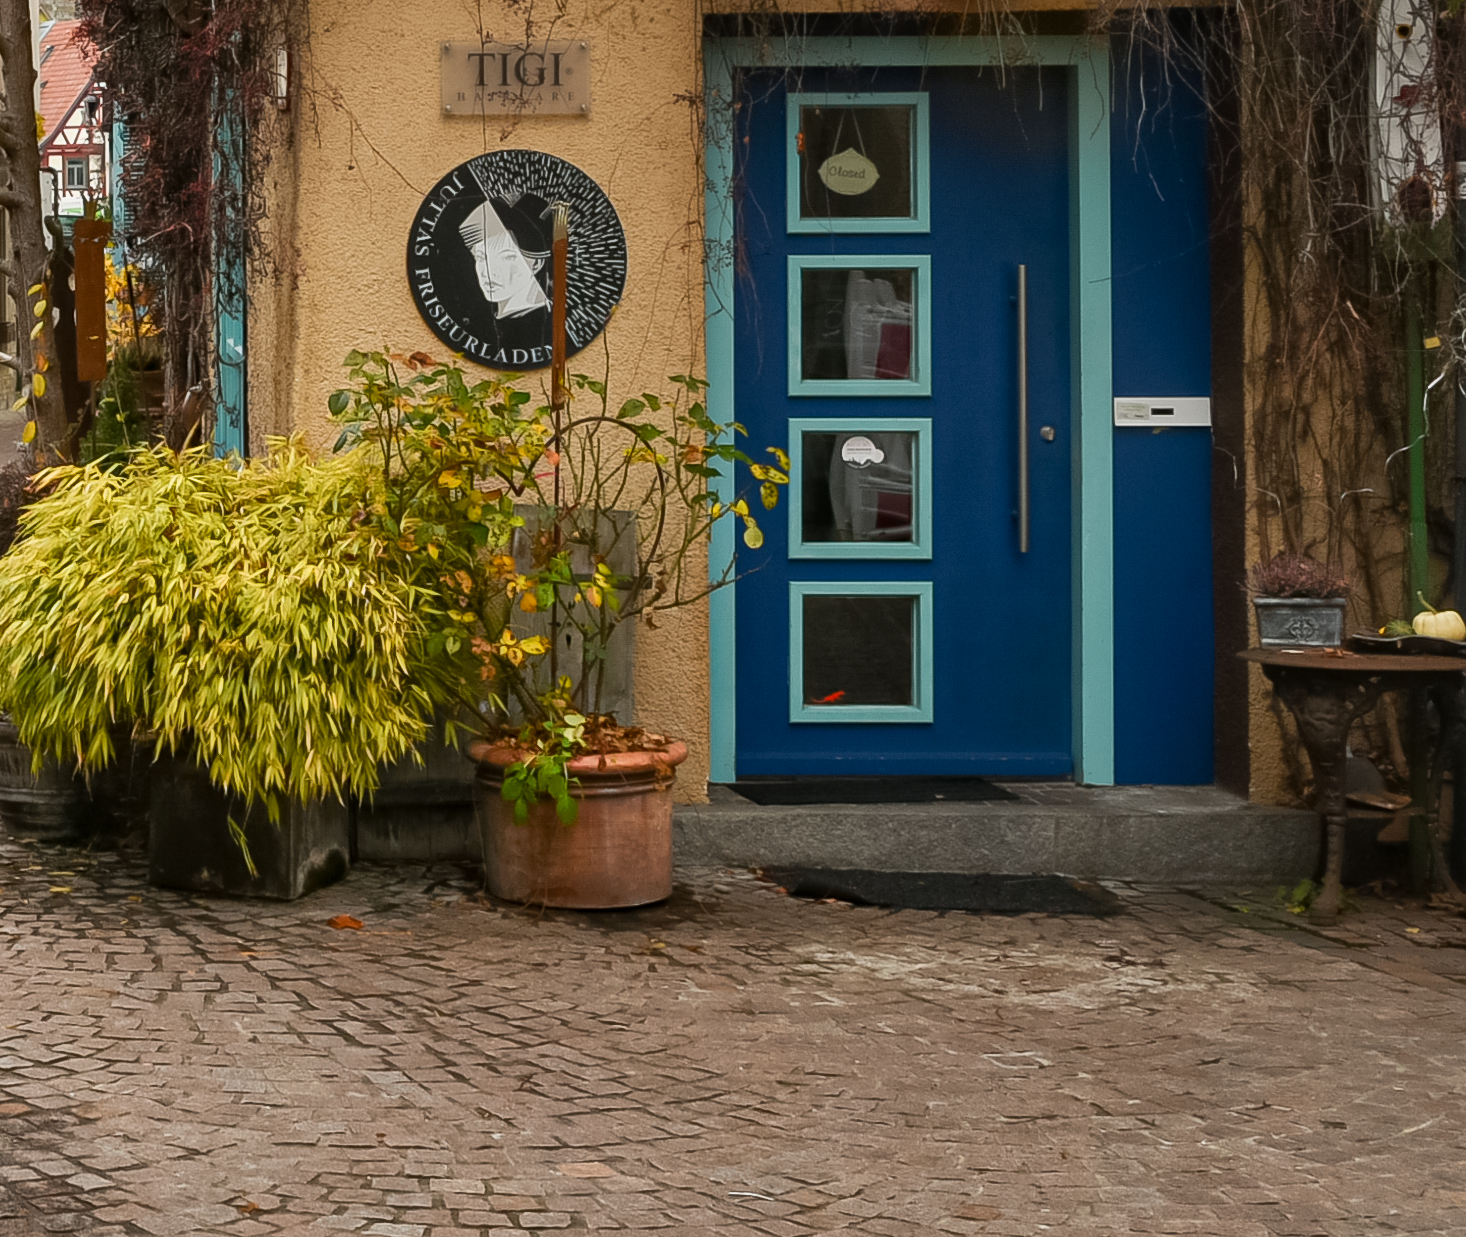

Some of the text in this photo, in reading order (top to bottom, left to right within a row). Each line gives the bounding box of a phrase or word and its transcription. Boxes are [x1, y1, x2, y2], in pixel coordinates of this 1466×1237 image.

[468, 52, 564, 87] TIGI
[457, 92, 575, 102] HAIRARE
[828, 165, 866, 179] Closed
